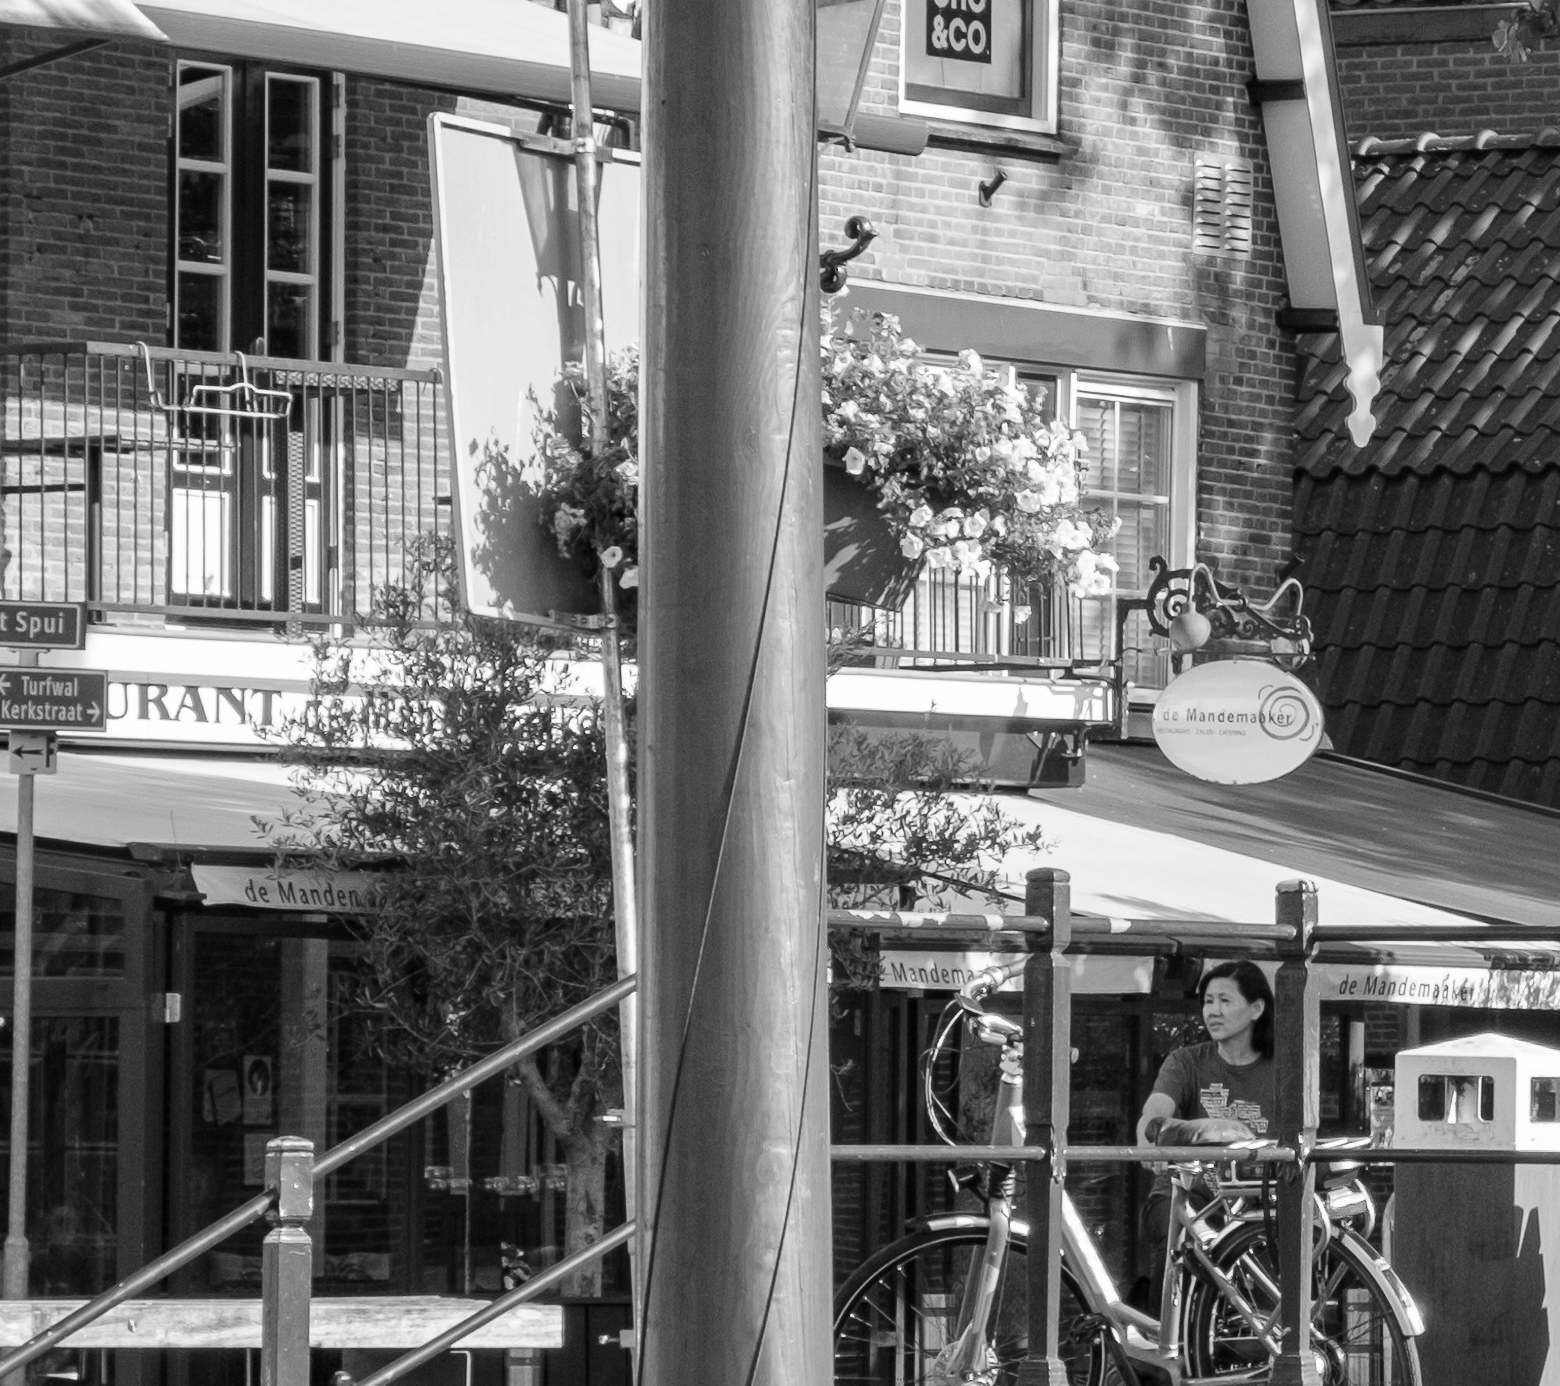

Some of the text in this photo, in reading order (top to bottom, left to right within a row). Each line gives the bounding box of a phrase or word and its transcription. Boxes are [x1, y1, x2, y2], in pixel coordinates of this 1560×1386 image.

[15, 611, 65, 639] Spui
[20, 675, 79, 698] Turfwal
[0, 699, 83, 722] Kerkstraat
[1162, 708, 1179, 722] de
[245, 879, 269, 904] de
[1338, 973, 1358, 996] de
